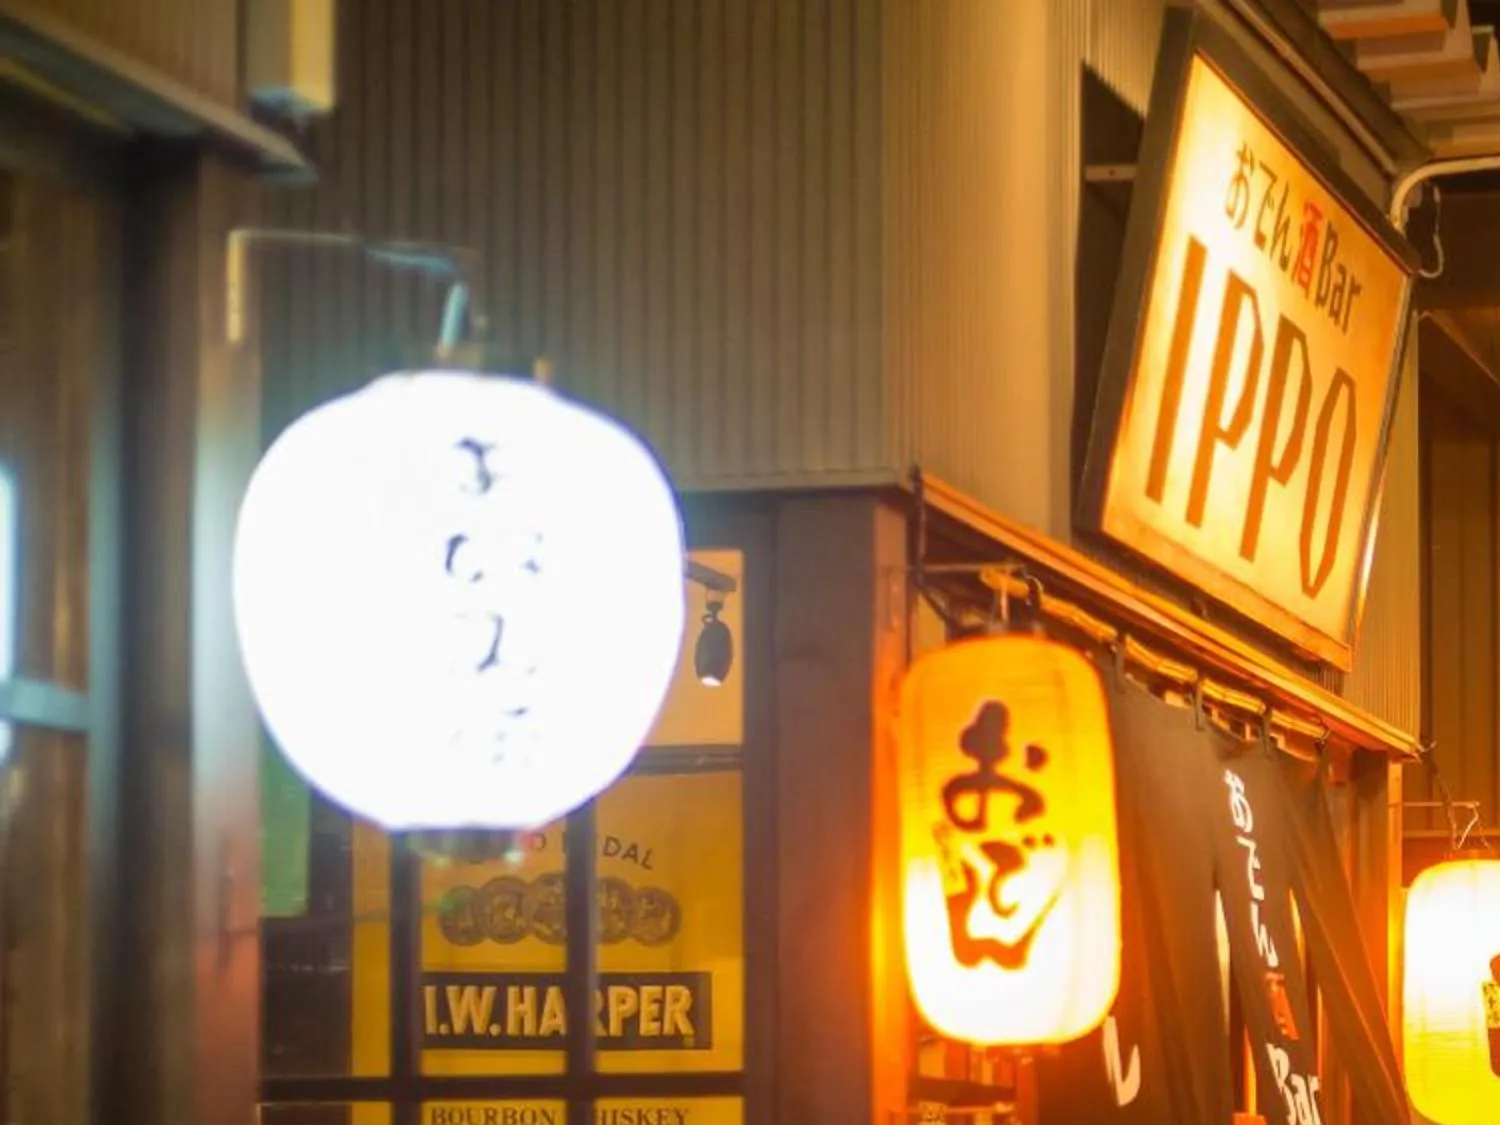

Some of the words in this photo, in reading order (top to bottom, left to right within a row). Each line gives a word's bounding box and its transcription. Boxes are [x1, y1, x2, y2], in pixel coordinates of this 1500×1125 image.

[1145, 233, 1358, 600] IPPO
[942, 700, 1061, 971] おでん
